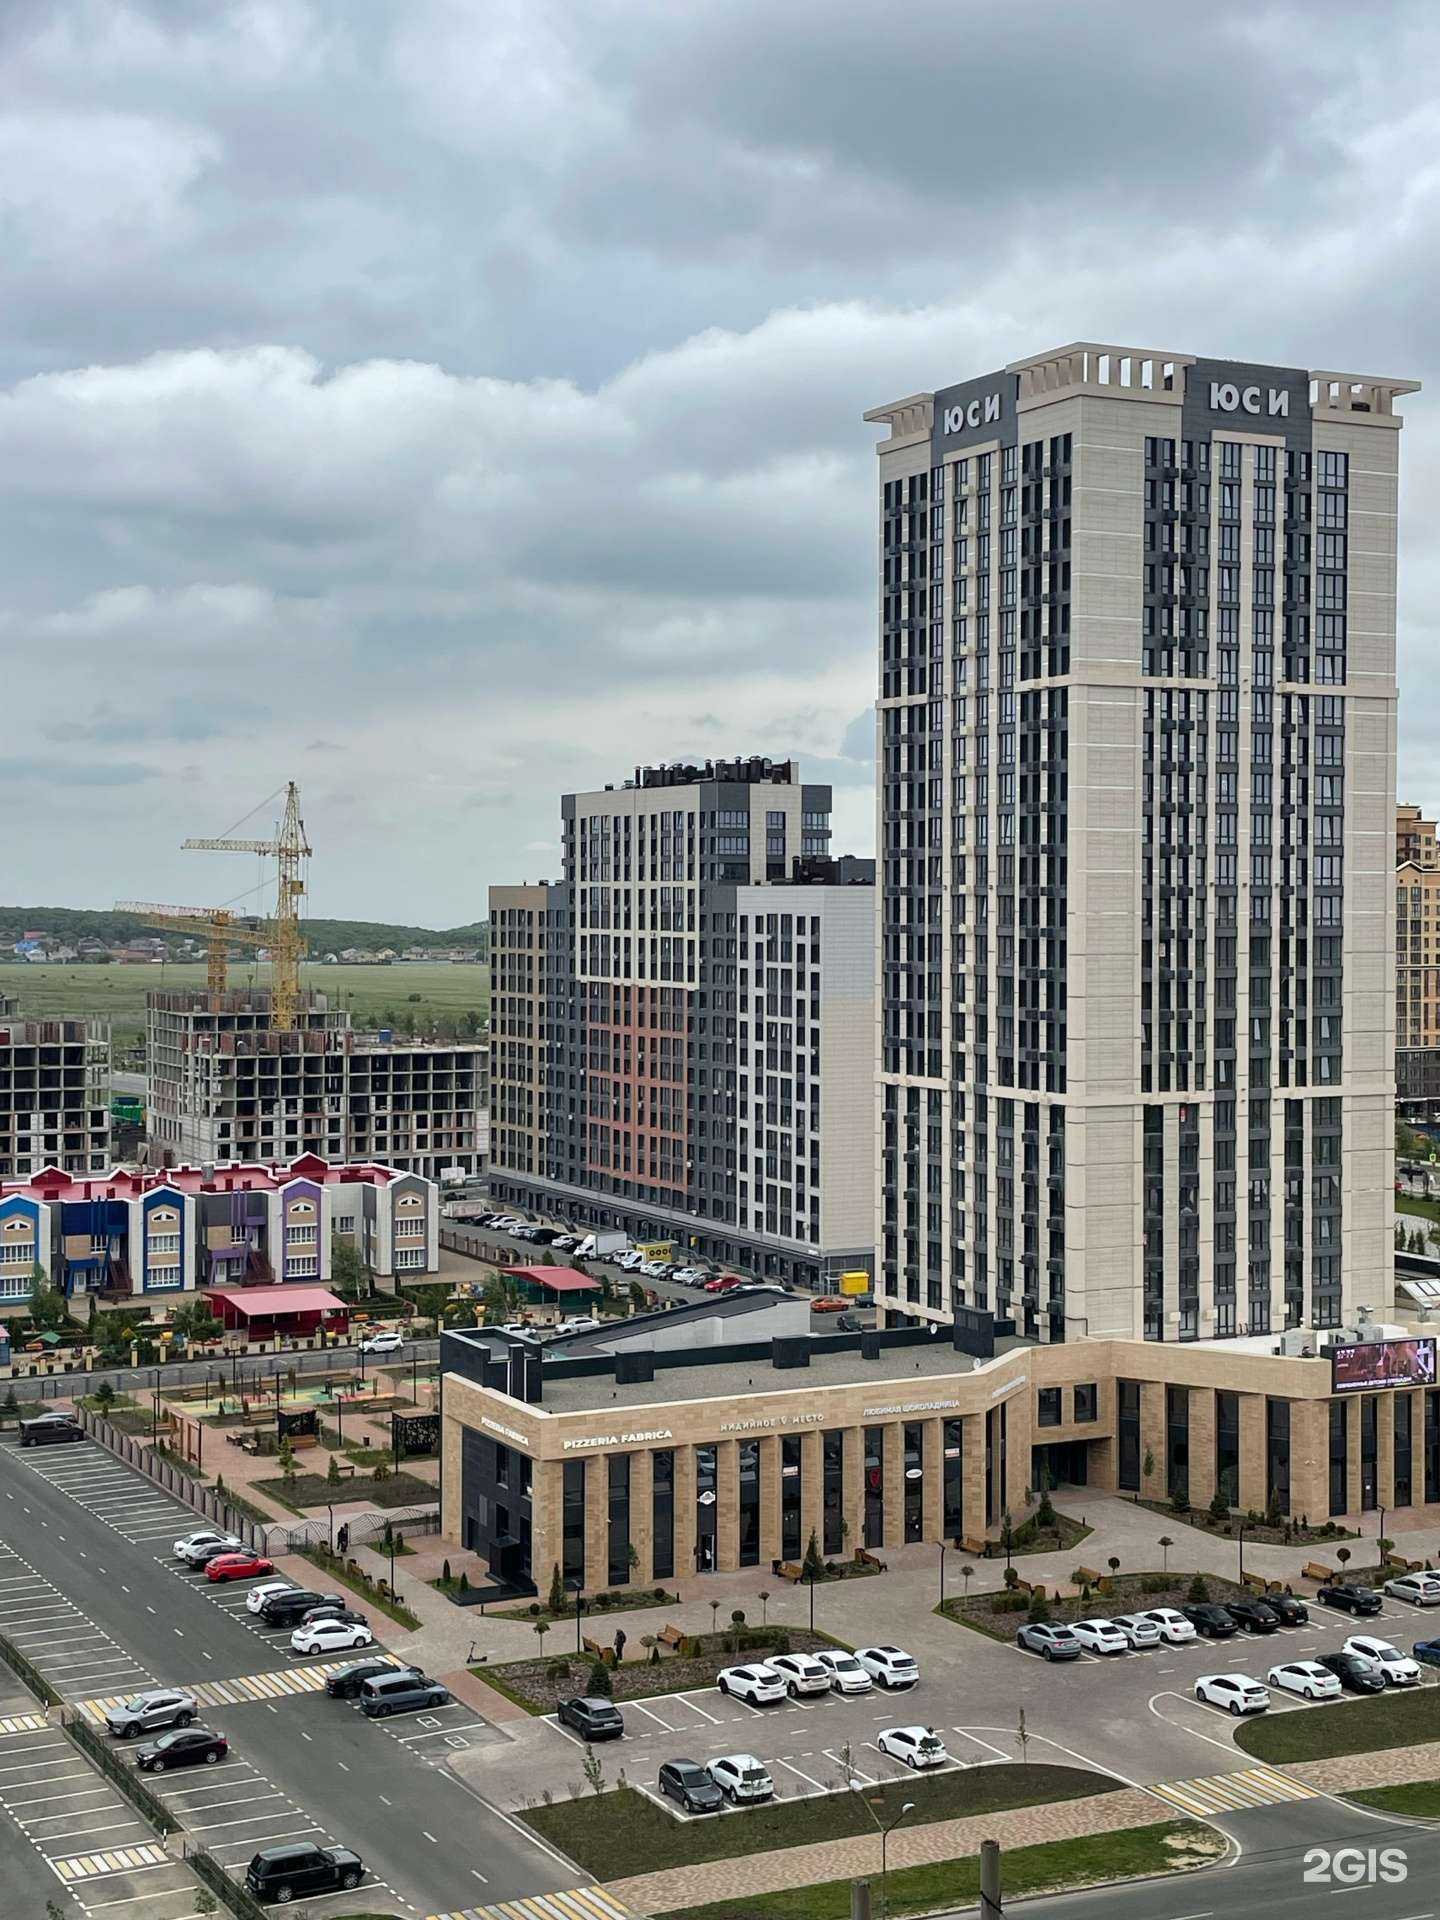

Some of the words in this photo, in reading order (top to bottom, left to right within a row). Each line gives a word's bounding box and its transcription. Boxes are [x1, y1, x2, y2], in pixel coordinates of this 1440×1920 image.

[1210, 382, 1289, 417] ЮСИ
[944, 393, 1001, 435] ЮСИ
[792, 1414, 824, 1425] МЕСТО
[563, 1436, 618, 1450] PIZZERIA
[621, 1430, 672, 1443] FABRICA
